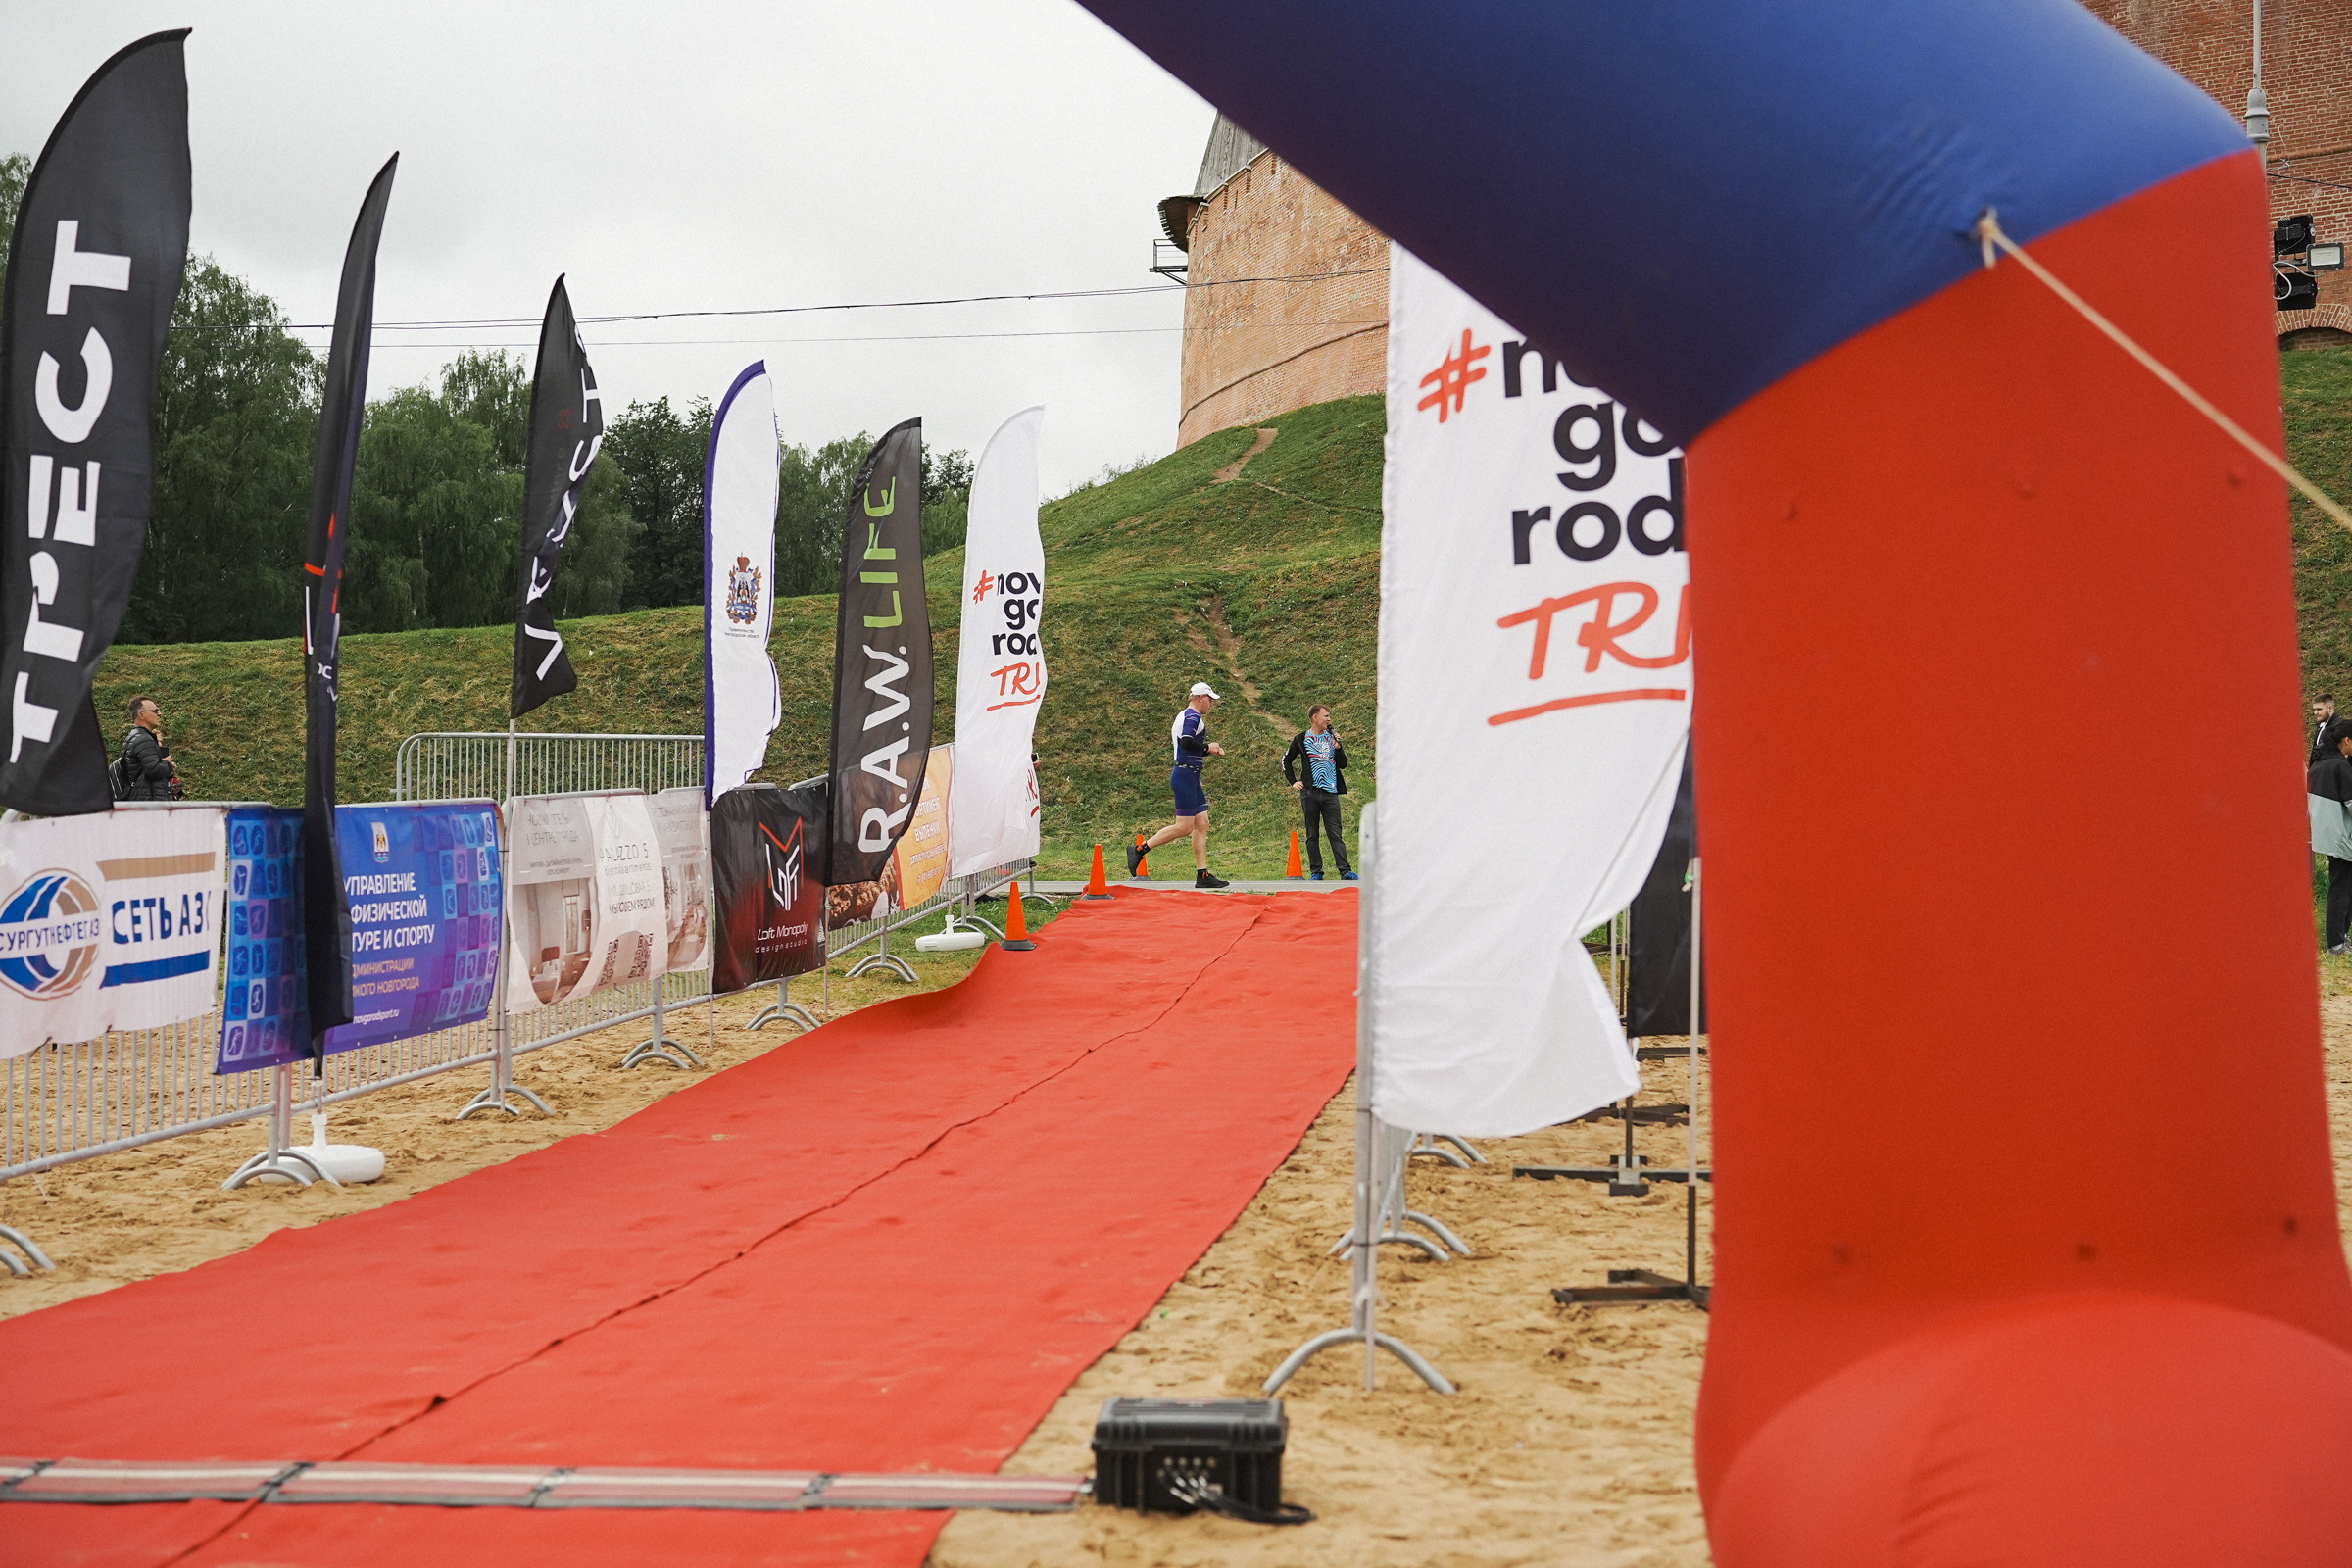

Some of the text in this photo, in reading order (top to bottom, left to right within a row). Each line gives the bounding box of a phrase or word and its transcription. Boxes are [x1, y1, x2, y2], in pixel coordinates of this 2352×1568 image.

[10, 220, 131, 763] ТРЕСТ
[1512, 459, 1688, 565] rod
[858, 476, 911, 853] R.A.W. LIFE
[343, 872, 416, 896] УПРАВЛЕНИЕ
[112, 897, 172, 945] СЕТЬ
[351, 894, 427, 924] ФИЗИЧЕСКОЙ
[352, 924, 435, 953] ТУРЕ И СПОРТУ
[758, 921, 808, 941] Loft Monopoly
[755, 938, 808, 954] design studio
[352, 957, 414, 979] ДМИНИСТРАЦИИ
[377, 976, 419, 994] НОВГОРОДА
